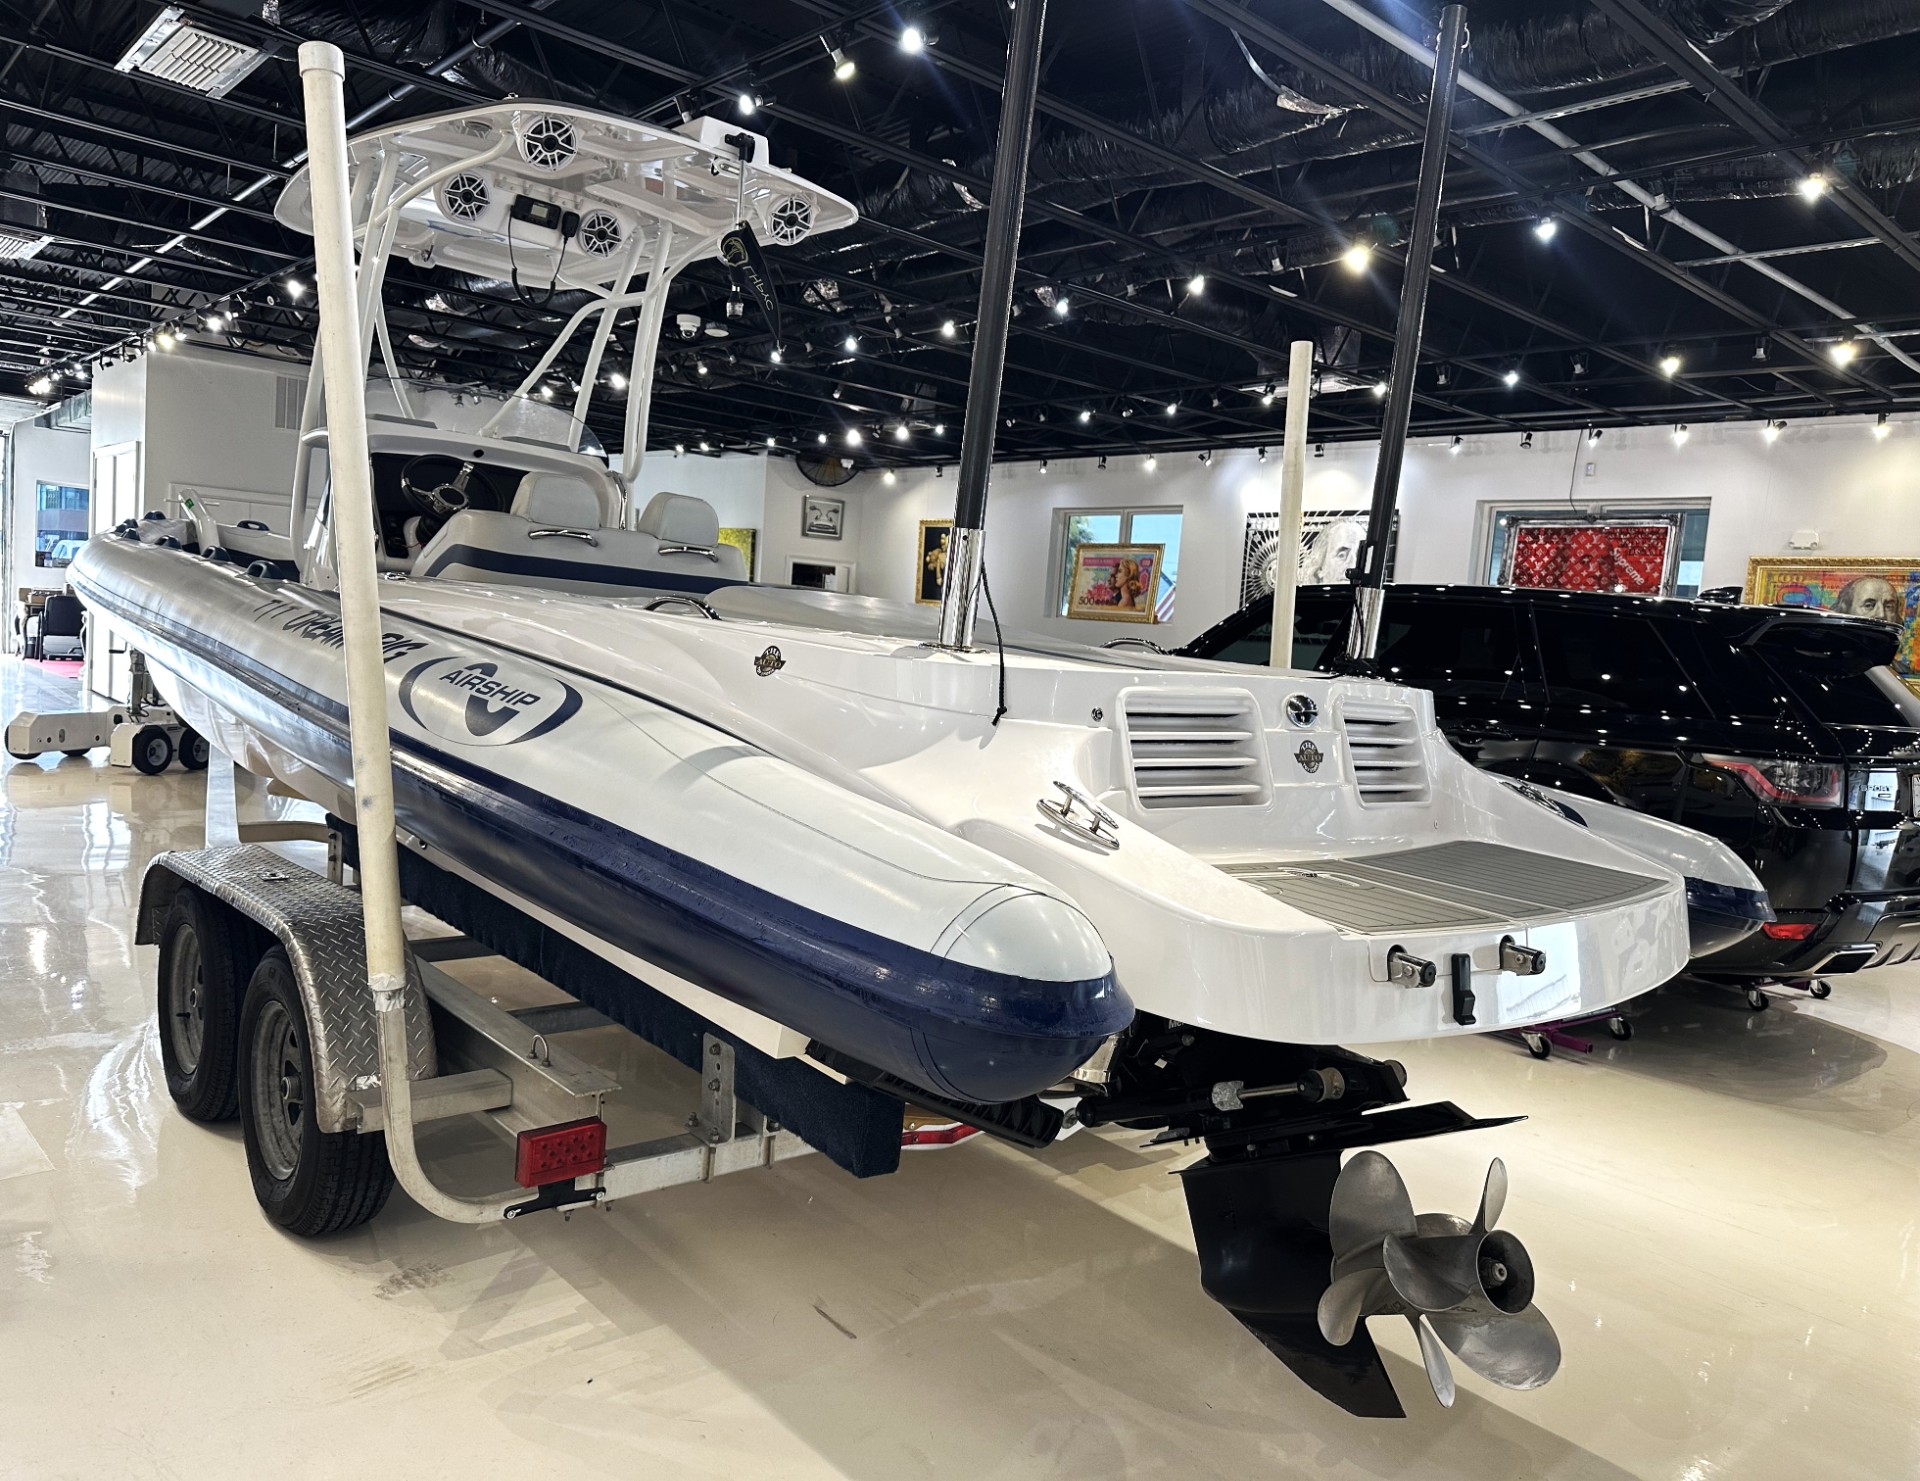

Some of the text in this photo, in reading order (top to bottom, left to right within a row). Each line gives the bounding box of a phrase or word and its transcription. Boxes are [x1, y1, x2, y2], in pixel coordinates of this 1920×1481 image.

[1611, 547, 1645, 586] Supreme
[756, 658, 782, 669] AUTO
[438, 669, 542, 706] AIRSHIP
[1298, 753, 1321, 762] AUTO
